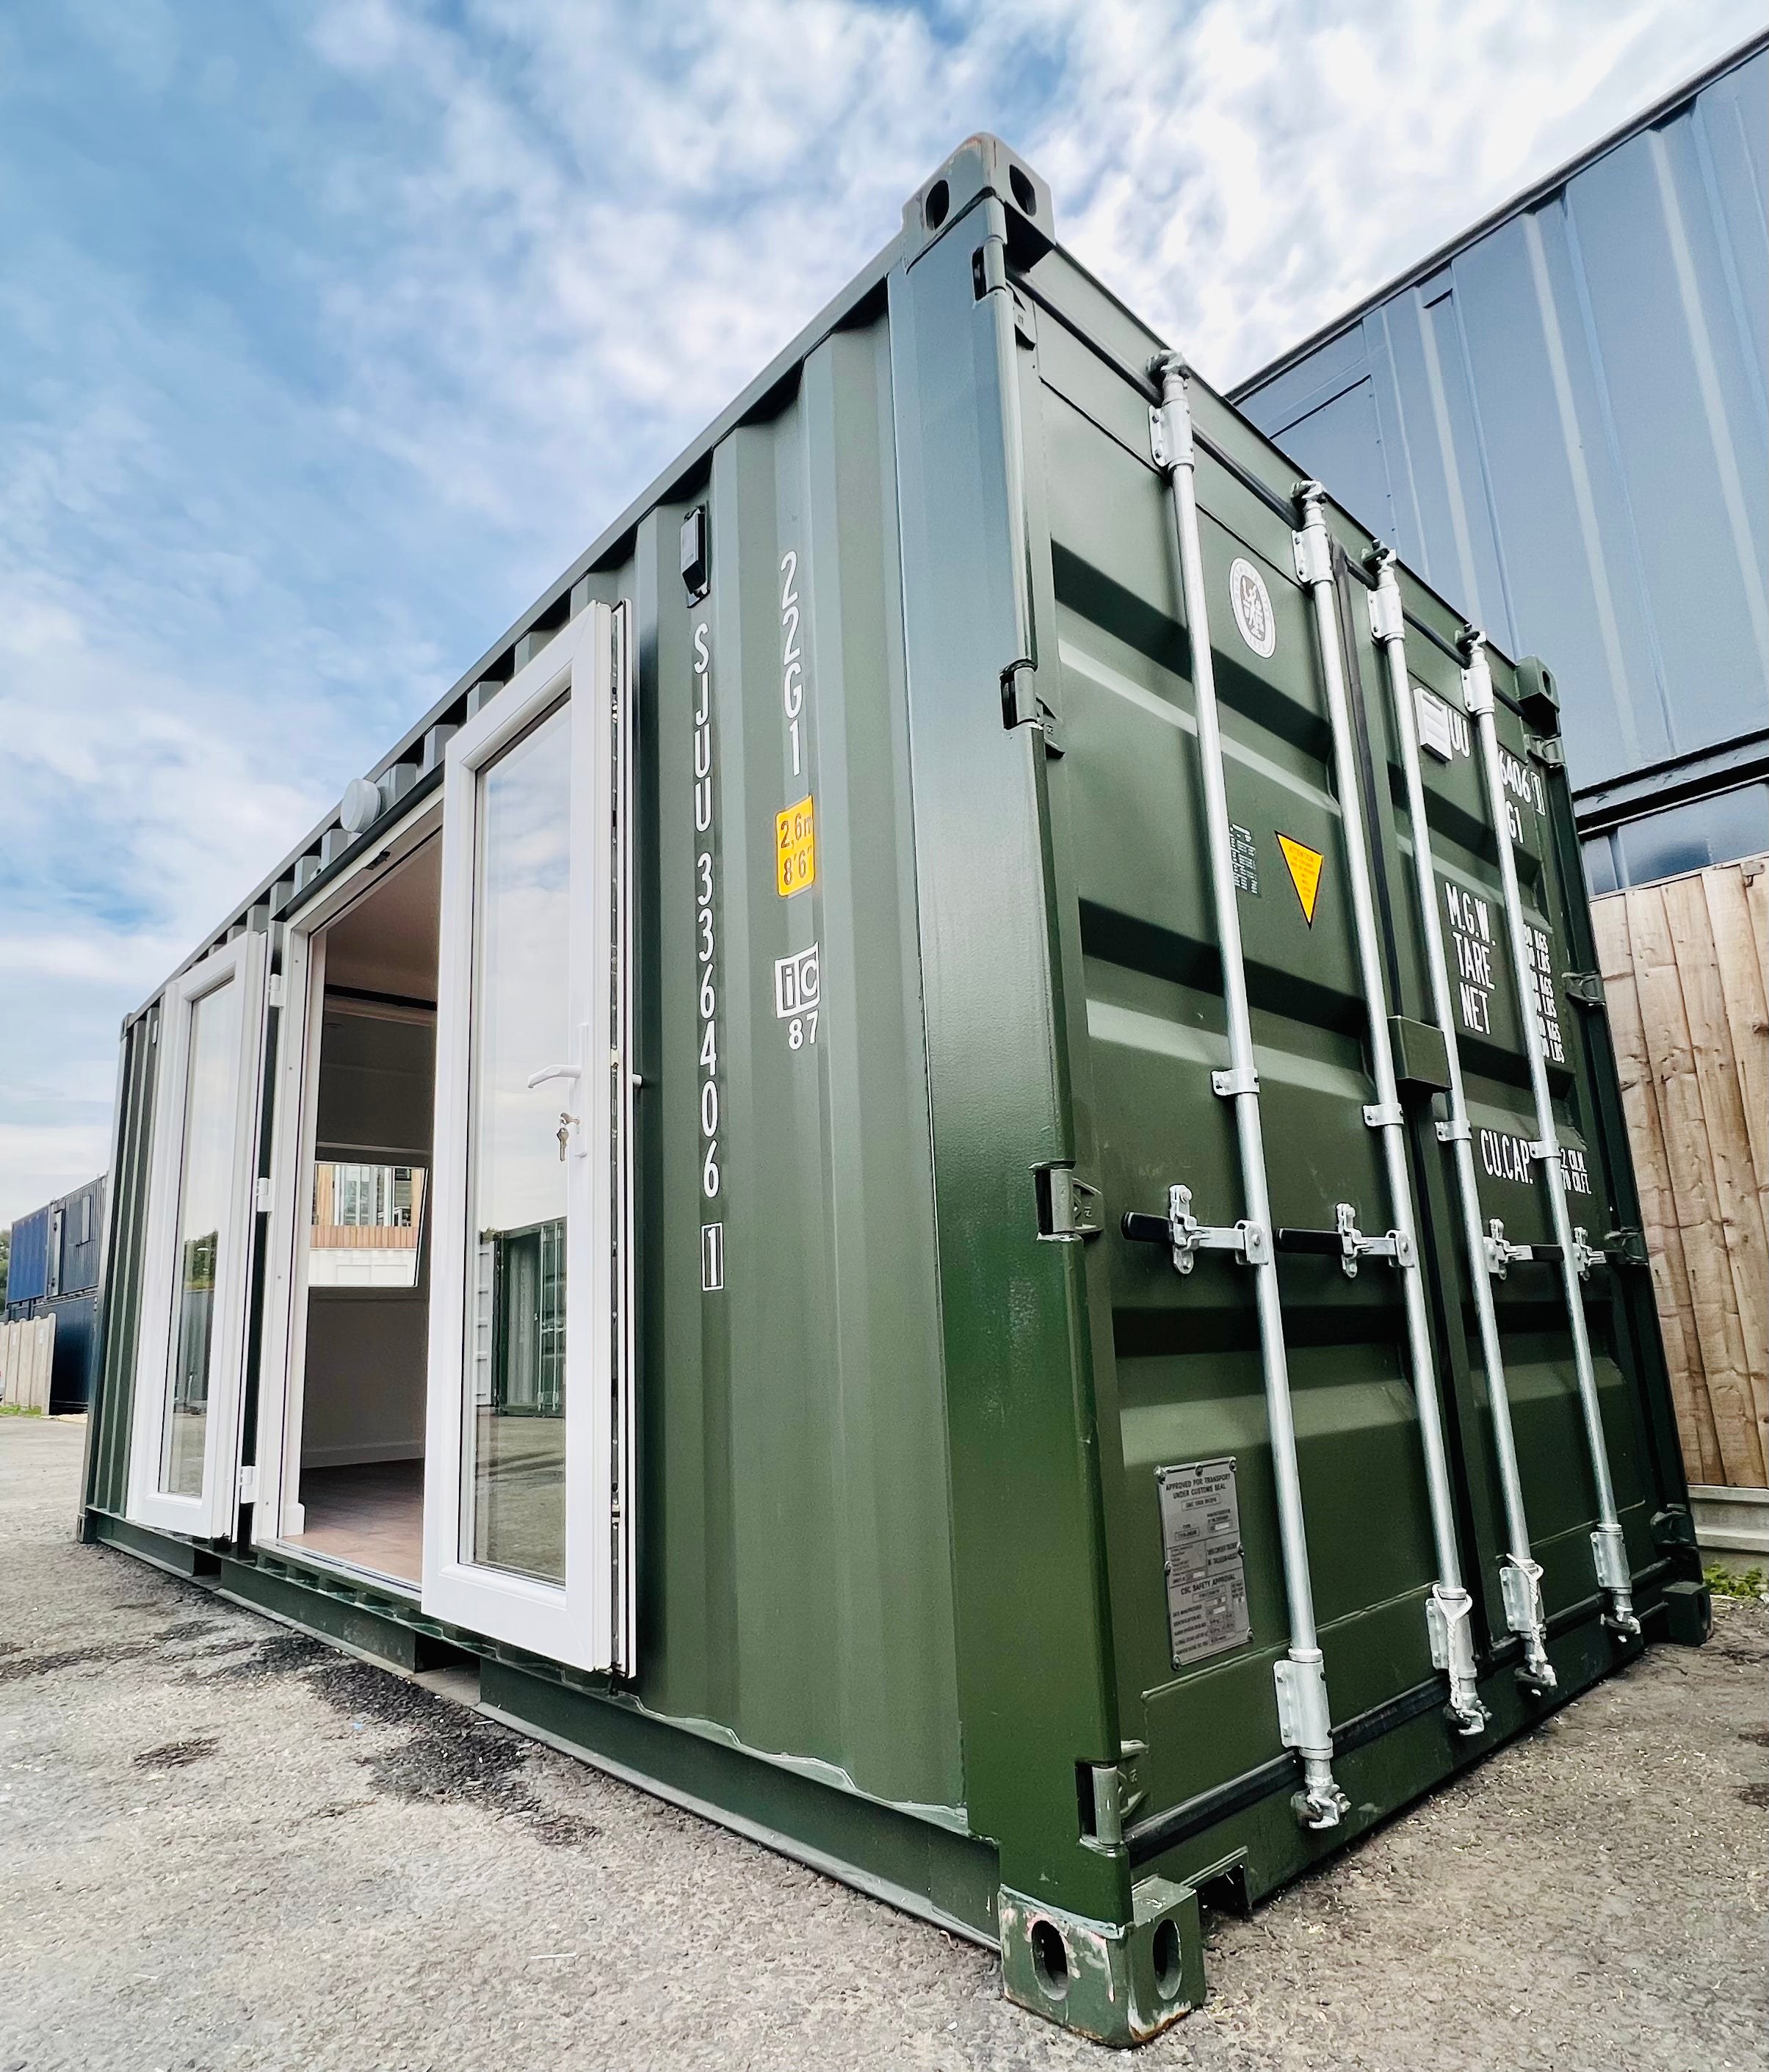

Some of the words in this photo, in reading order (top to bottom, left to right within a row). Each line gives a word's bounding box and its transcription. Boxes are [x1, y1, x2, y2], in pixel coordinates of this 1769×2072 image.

[780, 550, 803, 777] 22G1
[693, 623, 712, 833] SJUU
[1499, 750, 1531, 803] 6406
[1506, 800, 1524, 844] G1
[1445, 882, 1496, 946] M.G.W.
[1453, 931, 1495, 990] TARE
[697, 852, 719, 1198] 336406
[788, 1010, 819, 1050] 87
[1459, 982, 1491, 1035] NET
[1173, 1490, 1190, 1499] UNDER
[1191, 1485, 1212, 1496] CUSTOMS
[1214, 1483, 1226, 1491] SEAL
[1193, 1478, 1203, 1486] FOR
[1204, 1473, 1231, 1484] TRANSPORT
[1181, 1586, 1191, 1595] CSC
[1193, 1581, 1210, 1592] SAFETY
[1212, 1573, 1236, 1585] APPROVAL
